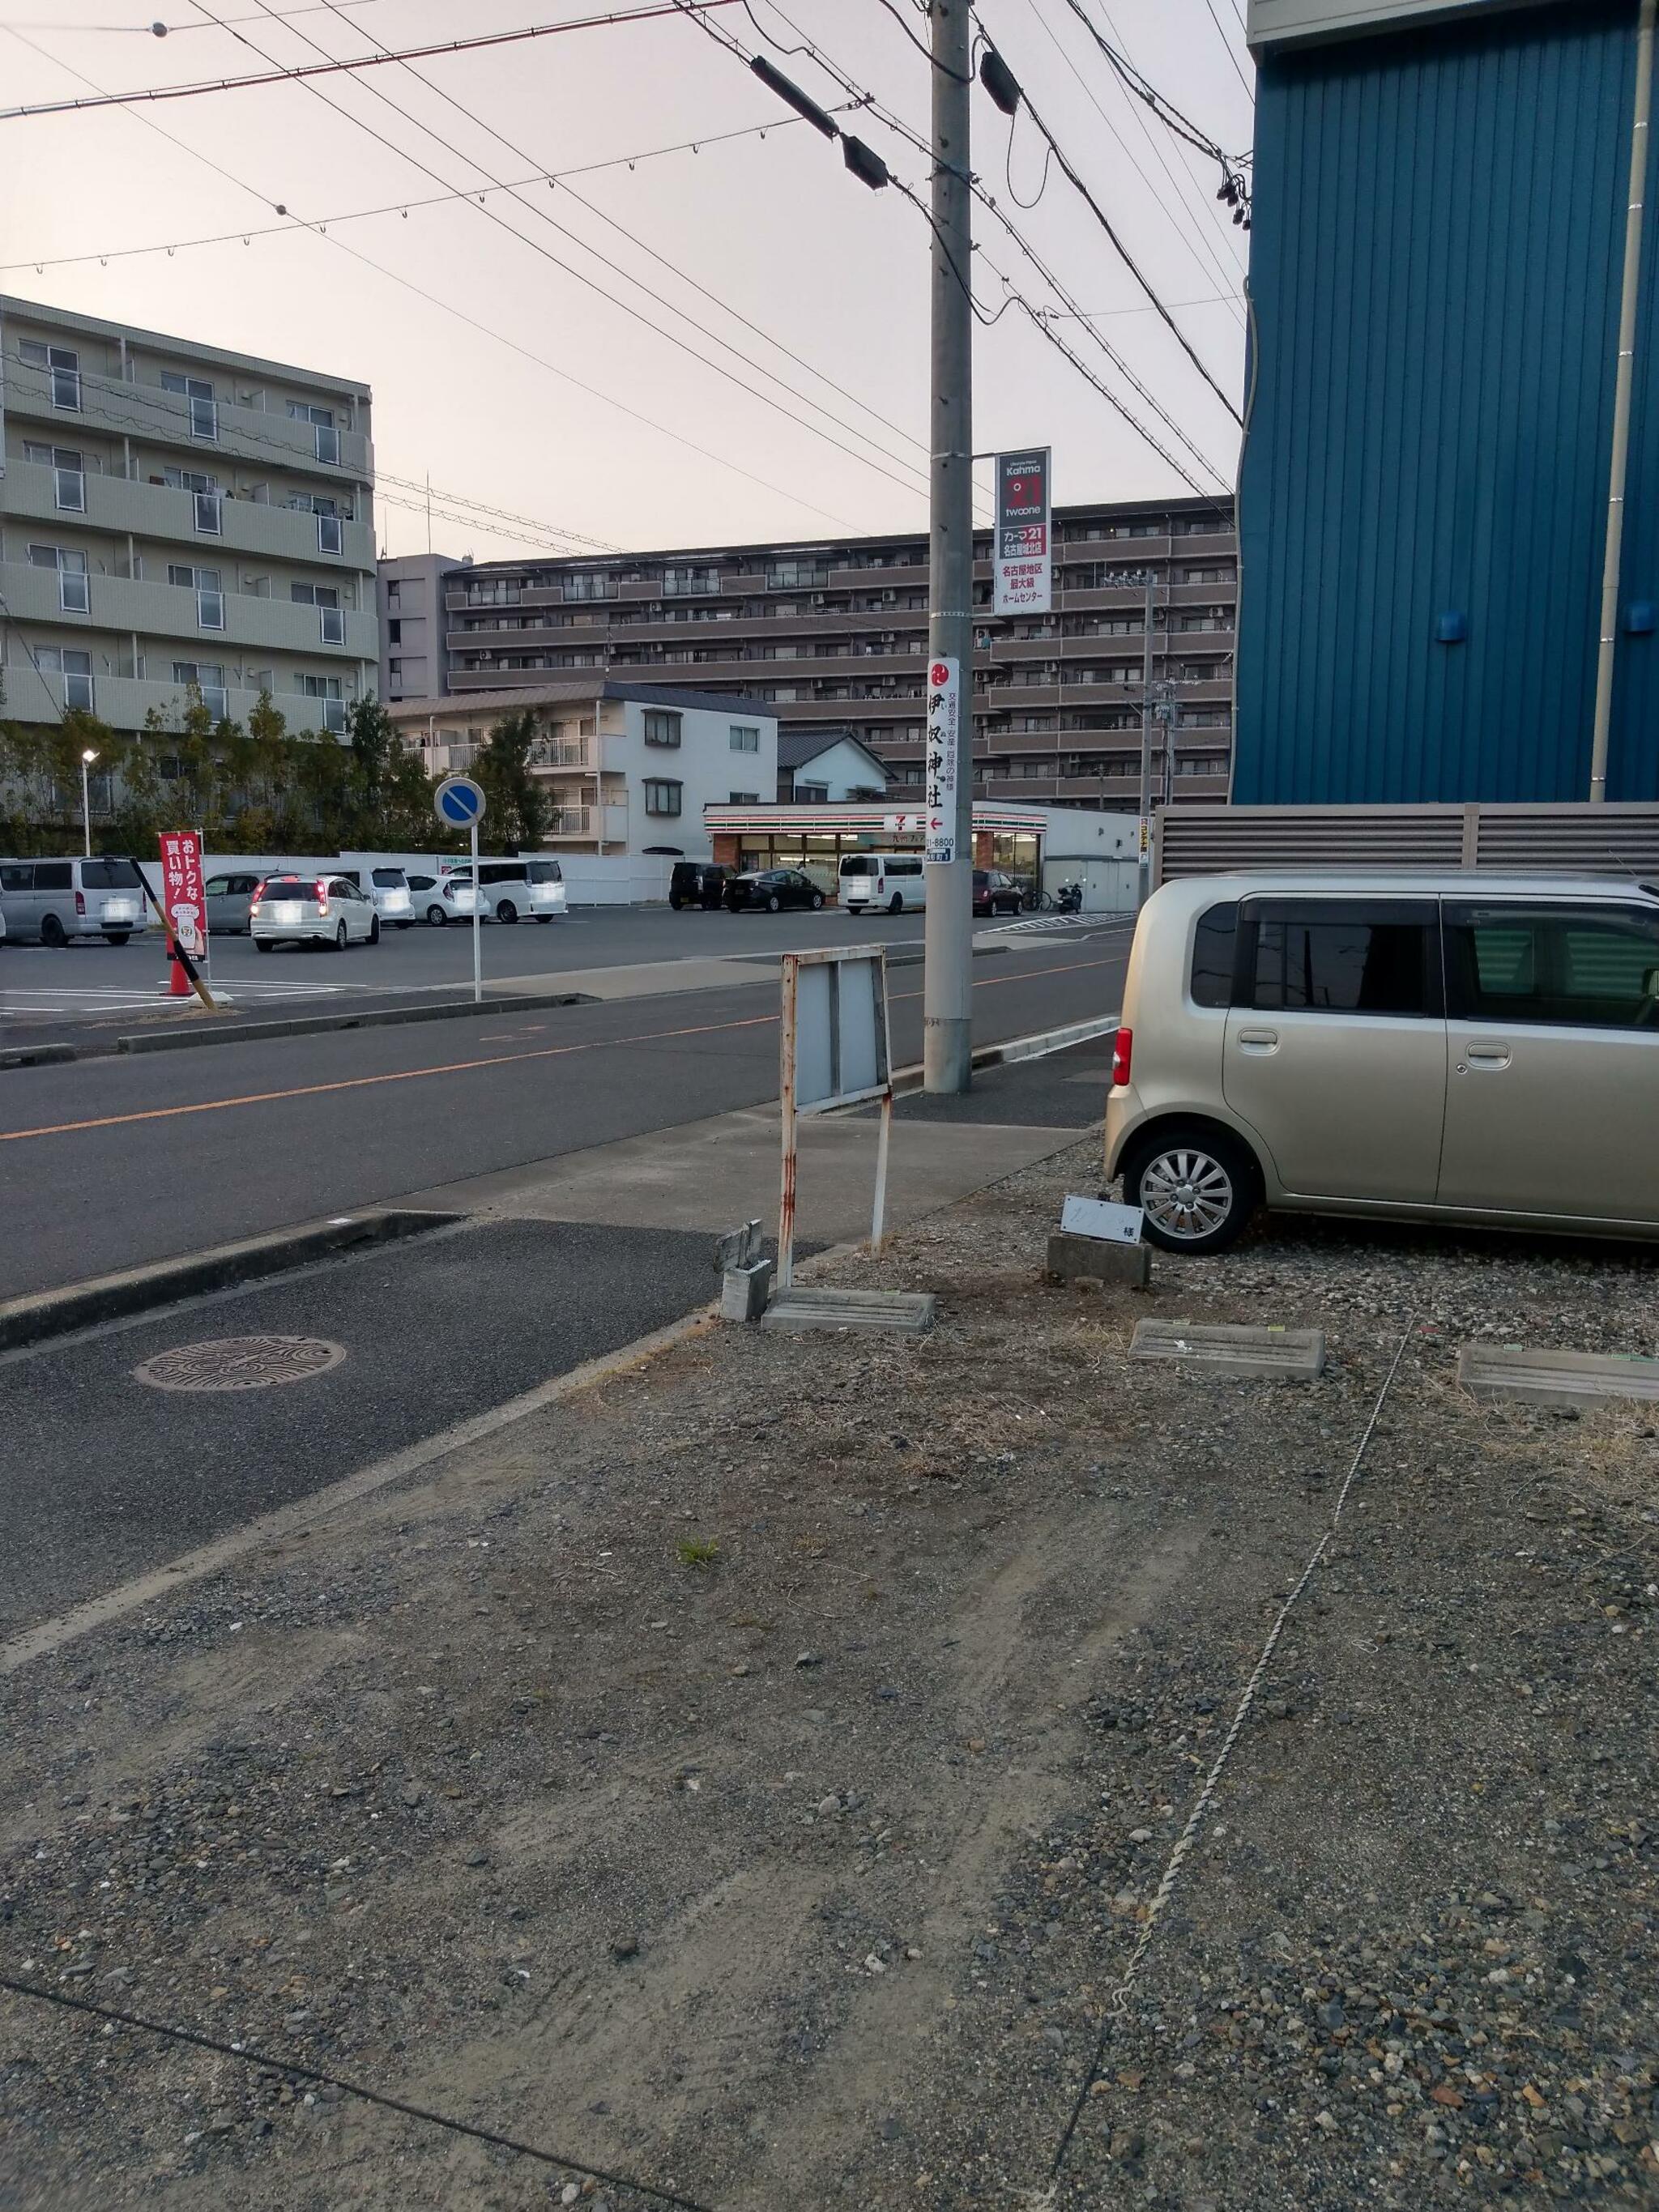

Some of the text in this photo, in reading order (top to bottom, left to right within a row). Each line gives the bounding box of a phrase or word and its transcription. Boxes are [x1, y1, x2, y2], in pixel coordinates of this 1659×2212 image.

[1006, 464, 1041, 475] Kahma
[1006, 505, 1041, 518] twoone
[1004, 542, 1043, 557] 名古屋城北店
[1002, 563, 1043, 578] 名古屋地区
[1009, 578, 1034, 590] 最大級
[1002, 593, 1043, 604] ホームセンター
[928, 693, 945, 808] 伊奴神社
[165, 839, 184, 899] 買い物！
[181, 839, 198, 901] おトクな
